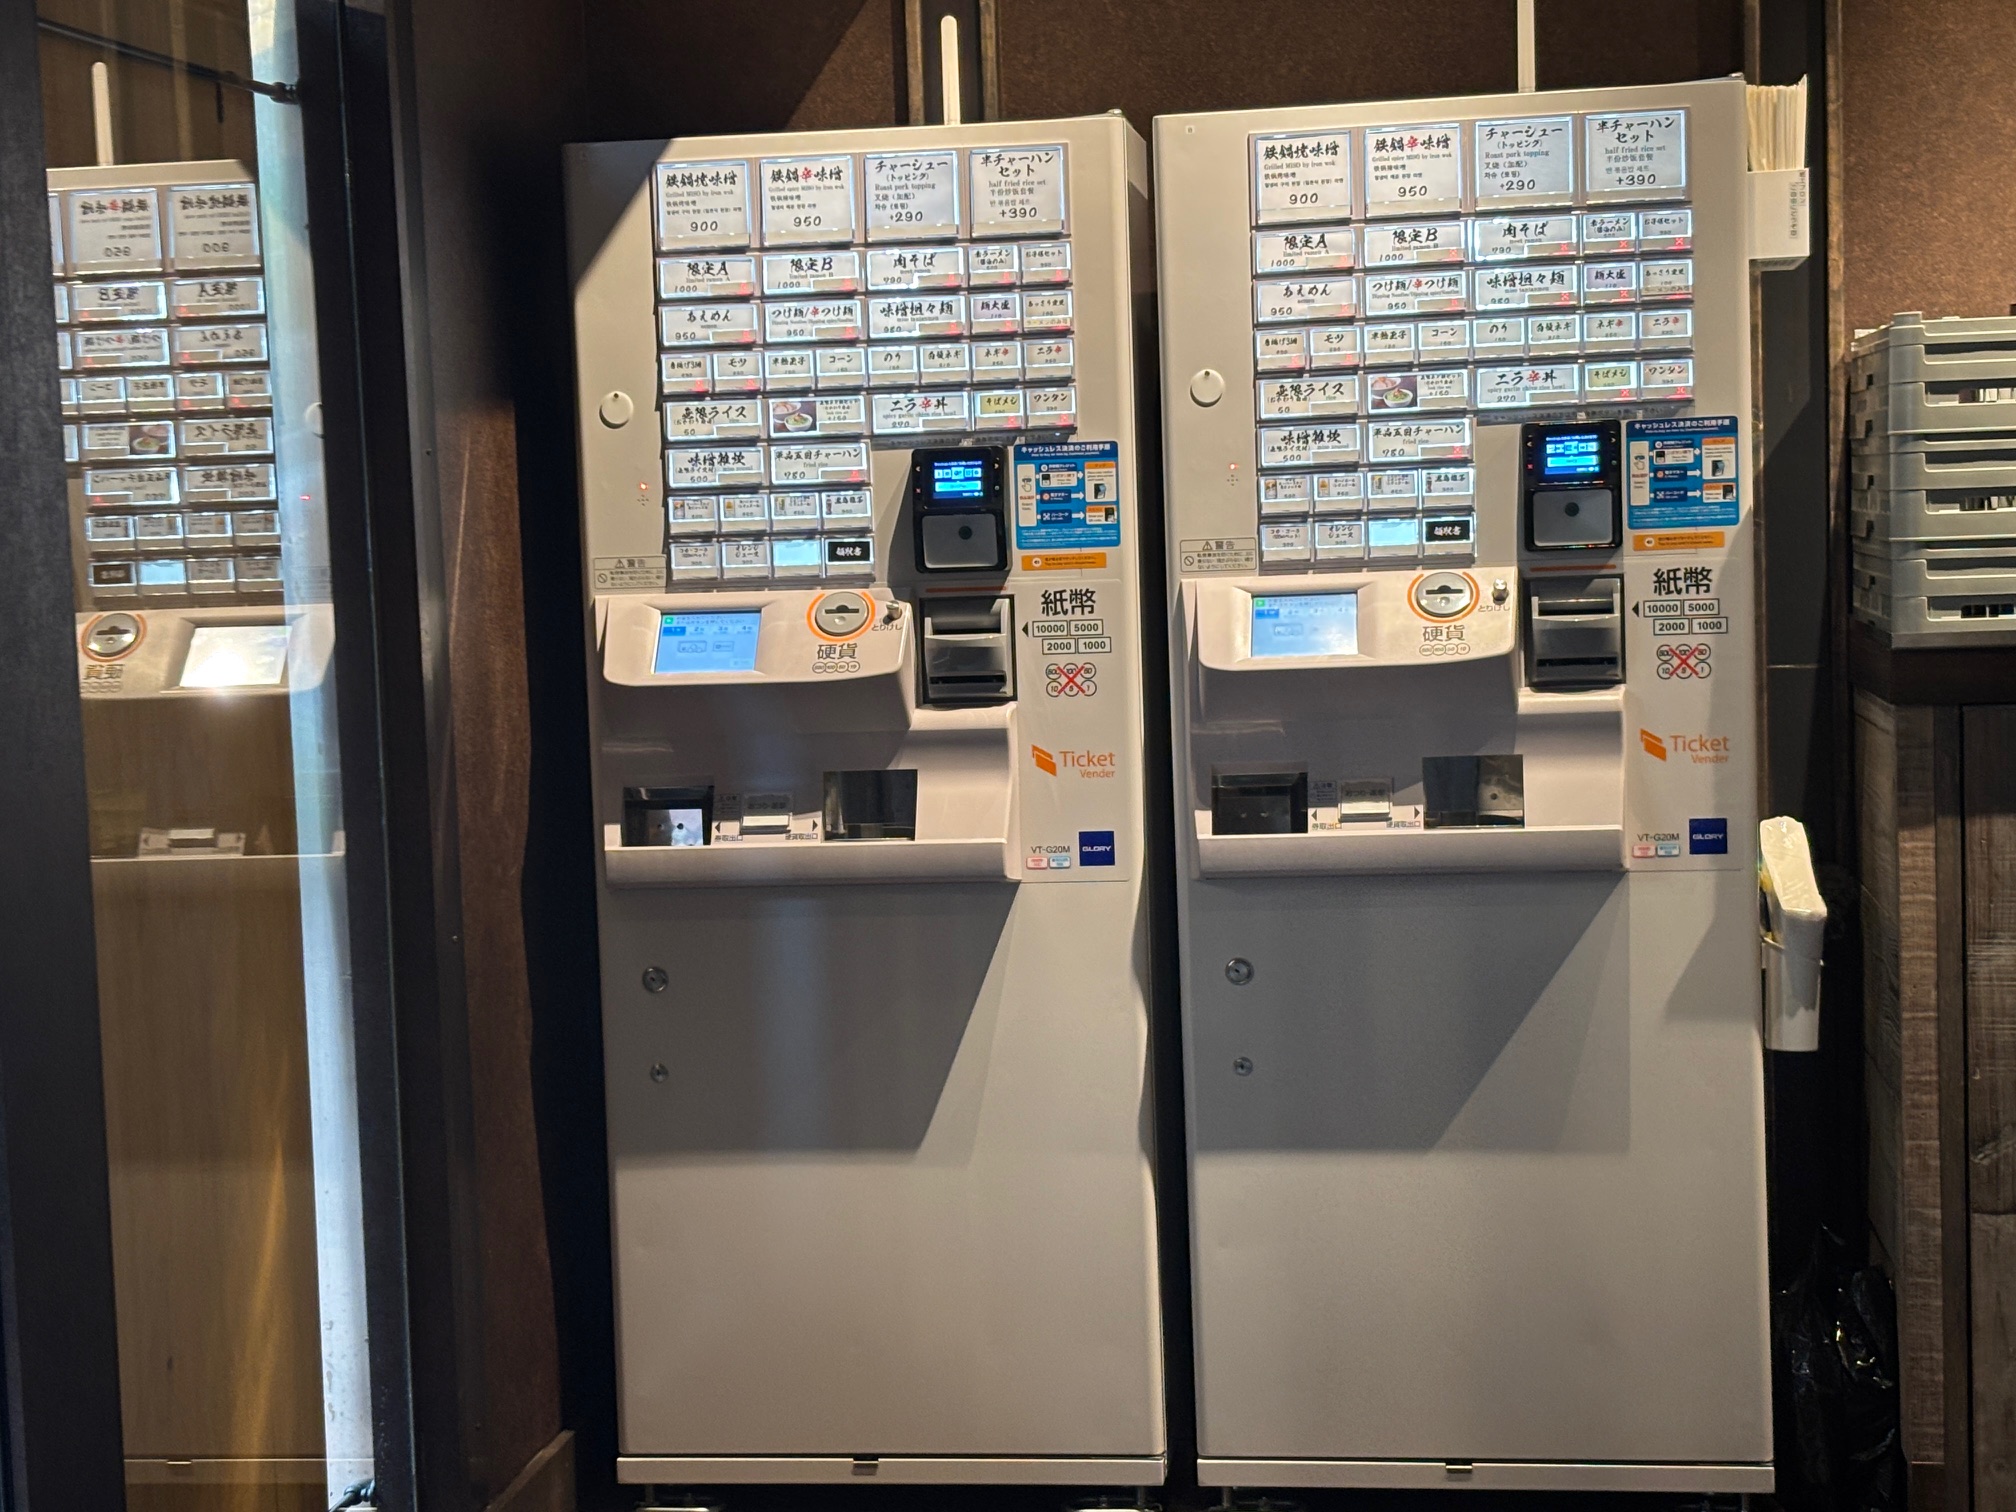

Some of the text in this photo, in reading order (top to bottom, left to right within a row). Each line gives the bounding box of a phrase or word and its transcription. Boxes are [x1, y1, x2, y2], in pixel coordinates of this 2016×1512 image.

[1597, 117, 1675, 133] 半チャーハン
[1486, 126, 1562, 140] チャーシュー
[1616, 130, 1654, 144] セット
[1506, 151, 1521, 160] pork
[1524, 150, 1549, 159] topping
[1621, 146, 1638, 154] fried
[981, 153, 1054, 166] 半チャーハン
[875, 159, 948, 172] チャーシュー
[999, 165, 1035, 177] セット
[1004, 179, 1020, 187] fried
[1616, 174, 1656, 186] +390
[875, 182, 936, 192] Roast pork topping
[1398, 186, 1427, 197] 950
[1289, 193, 1319, 205] 900
[999, 207, 1037, 219] +390
[690, 220, 718, 232] 900
[793, 216, 822, 227] 950
[1503, 222, 1549, 238] 肉そば
[1392, 228, 1438, 244] 限定B
[1284, 233, 1328, 250] 限定A
[893, 253, 936, 269] 肉そば
[1379, 253, 1404, 261] 1000
[790, 257, 833, 272] 限定B
[1271, 259, 1295, 267] 1000
[687, 260, 728, 277] 限定A
[674, 285, 698, 293] 1000
[777, 281, 800, 289] 1000
[1283, 284, 1332, 297] あえめん
[1270, 307, 1292, 315] 950
[1388, 302, 1406, 310] 950
[687, 309, 732, 323] あえめん
[674, 332, 696, 341] 950
[1432, 328, 1457, 336] コーン
[1324, 334, 1344, 343] モツ
[728, 358, 747, 367] モツ
[829, 355, 853, 364] コーン
[1648, 365, 1684, 375] ワンタン
[1034, 394, 1067, 402] ワンタン
[683, 428, 696, 436] 50
[1283, 454, 1301, 462] 500
[1653, 566, 1713, 596] 紙幣
[1041, 588, 1096, 616] 紙幣
[1478, 604, 1510, 613] とりけし
[1647, 603, 1715, 613] 10000 5000
[1036, 623, 1099, 633] 10000 5000
[1658, 621, 1722, 631] 2000 1000
[1422, 625, 1466, 642] 硬貨
[817, 642, 857, 660] 硬貨
[1047, 641, 1106, 651] 2000 1000
[1669, 734, 1730, 752] Ticket
[1059, 750, 1115, 767] Ticket
[1691, 754, 1729, 764] Vender
[1080, 769, 1115, 778] Vender
[1637, 833, 1680, 841] VT-G20M
